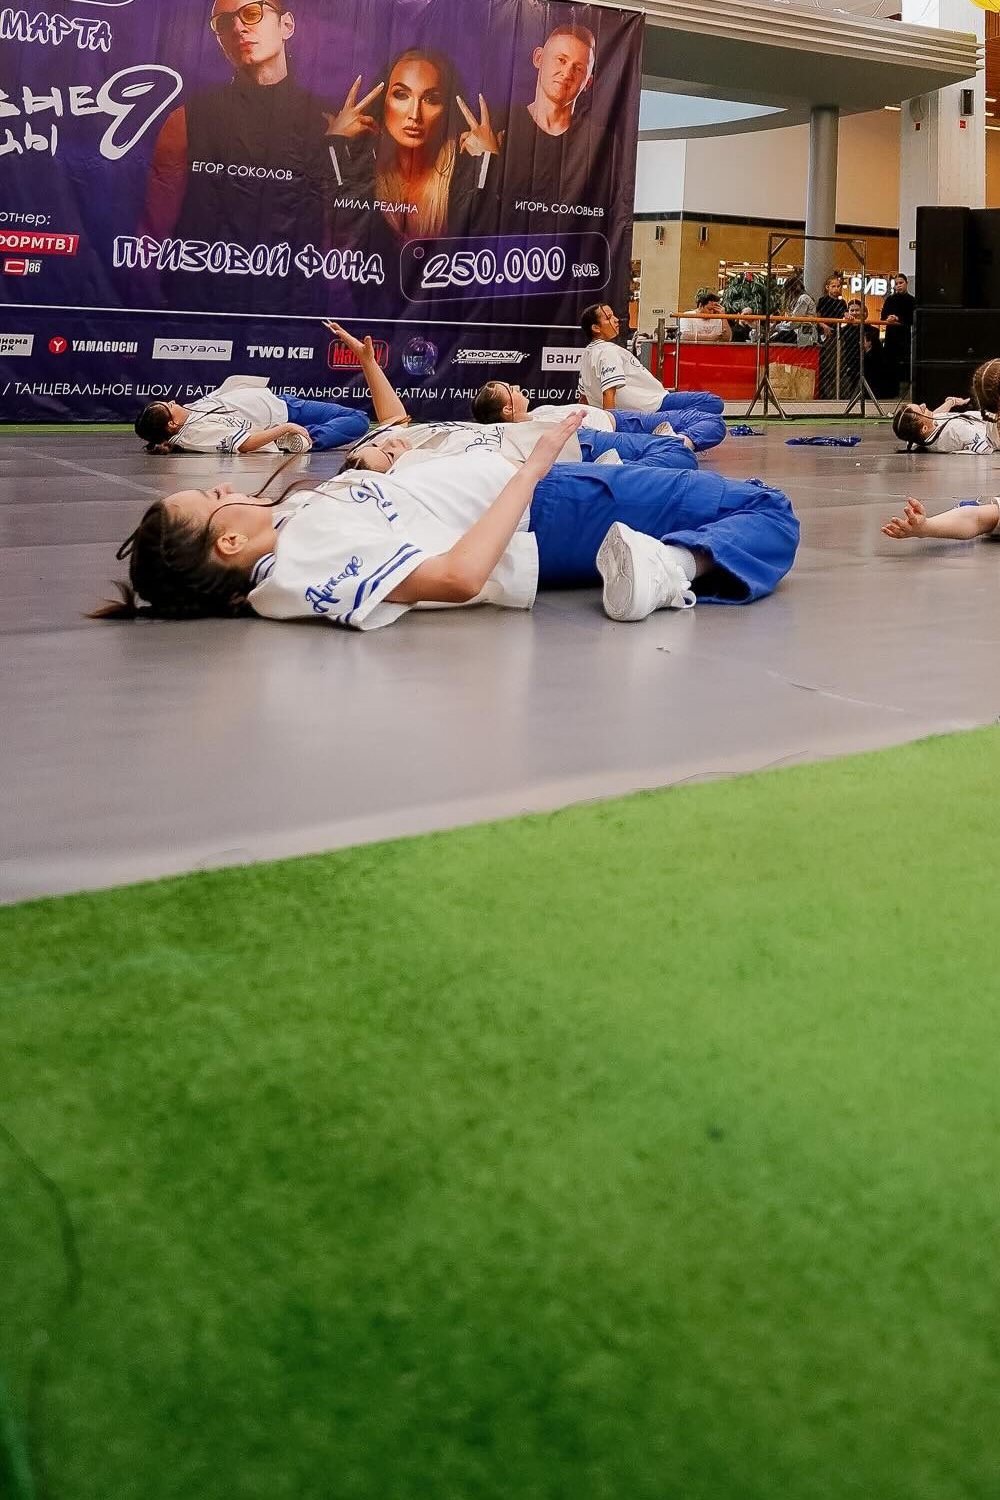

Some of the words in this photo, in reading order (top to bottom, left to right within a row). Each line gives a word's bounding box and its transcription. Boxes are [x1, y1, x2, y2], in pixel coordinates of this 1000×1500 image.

[0, 8, 112, 52] МАРТА
[192, 161, 224, 173] ЕГОР
[227, 164, 293, 180] СОКОЛОВ
[333, 198, 370, 211] МИЛА
[373, 201, 419, 214] РЕДИНА
[515, 200, 549, 213] ИГОРЬ
[551, 203, 604, 217] СОЛОВЬЕВ
[113, 235, 290, 277] ПРИЗОВОЙ
[421, 246, 566, 288] 250.000
[571, 263, 600, 277] RUB
[72, 340, 138, 353] YAMAGUCHI
[246, 345, 283, 358] TWO
[287, 347, 314, 359] KEI
[467, 351, 516, 359] ФОРСАЖ
[14, 382, 132, 396] ТАНЦЕВАЛЬНОЕ
[136, 384, 172, 396] ШОУ
[186, 385, 216, 396] БАТТ
[271, 386, 350, 398] ЦЕВАЛЬНОЕ
[352, 386, 373, 398] ШО
[538, 388, 565, 399] ШОУ
